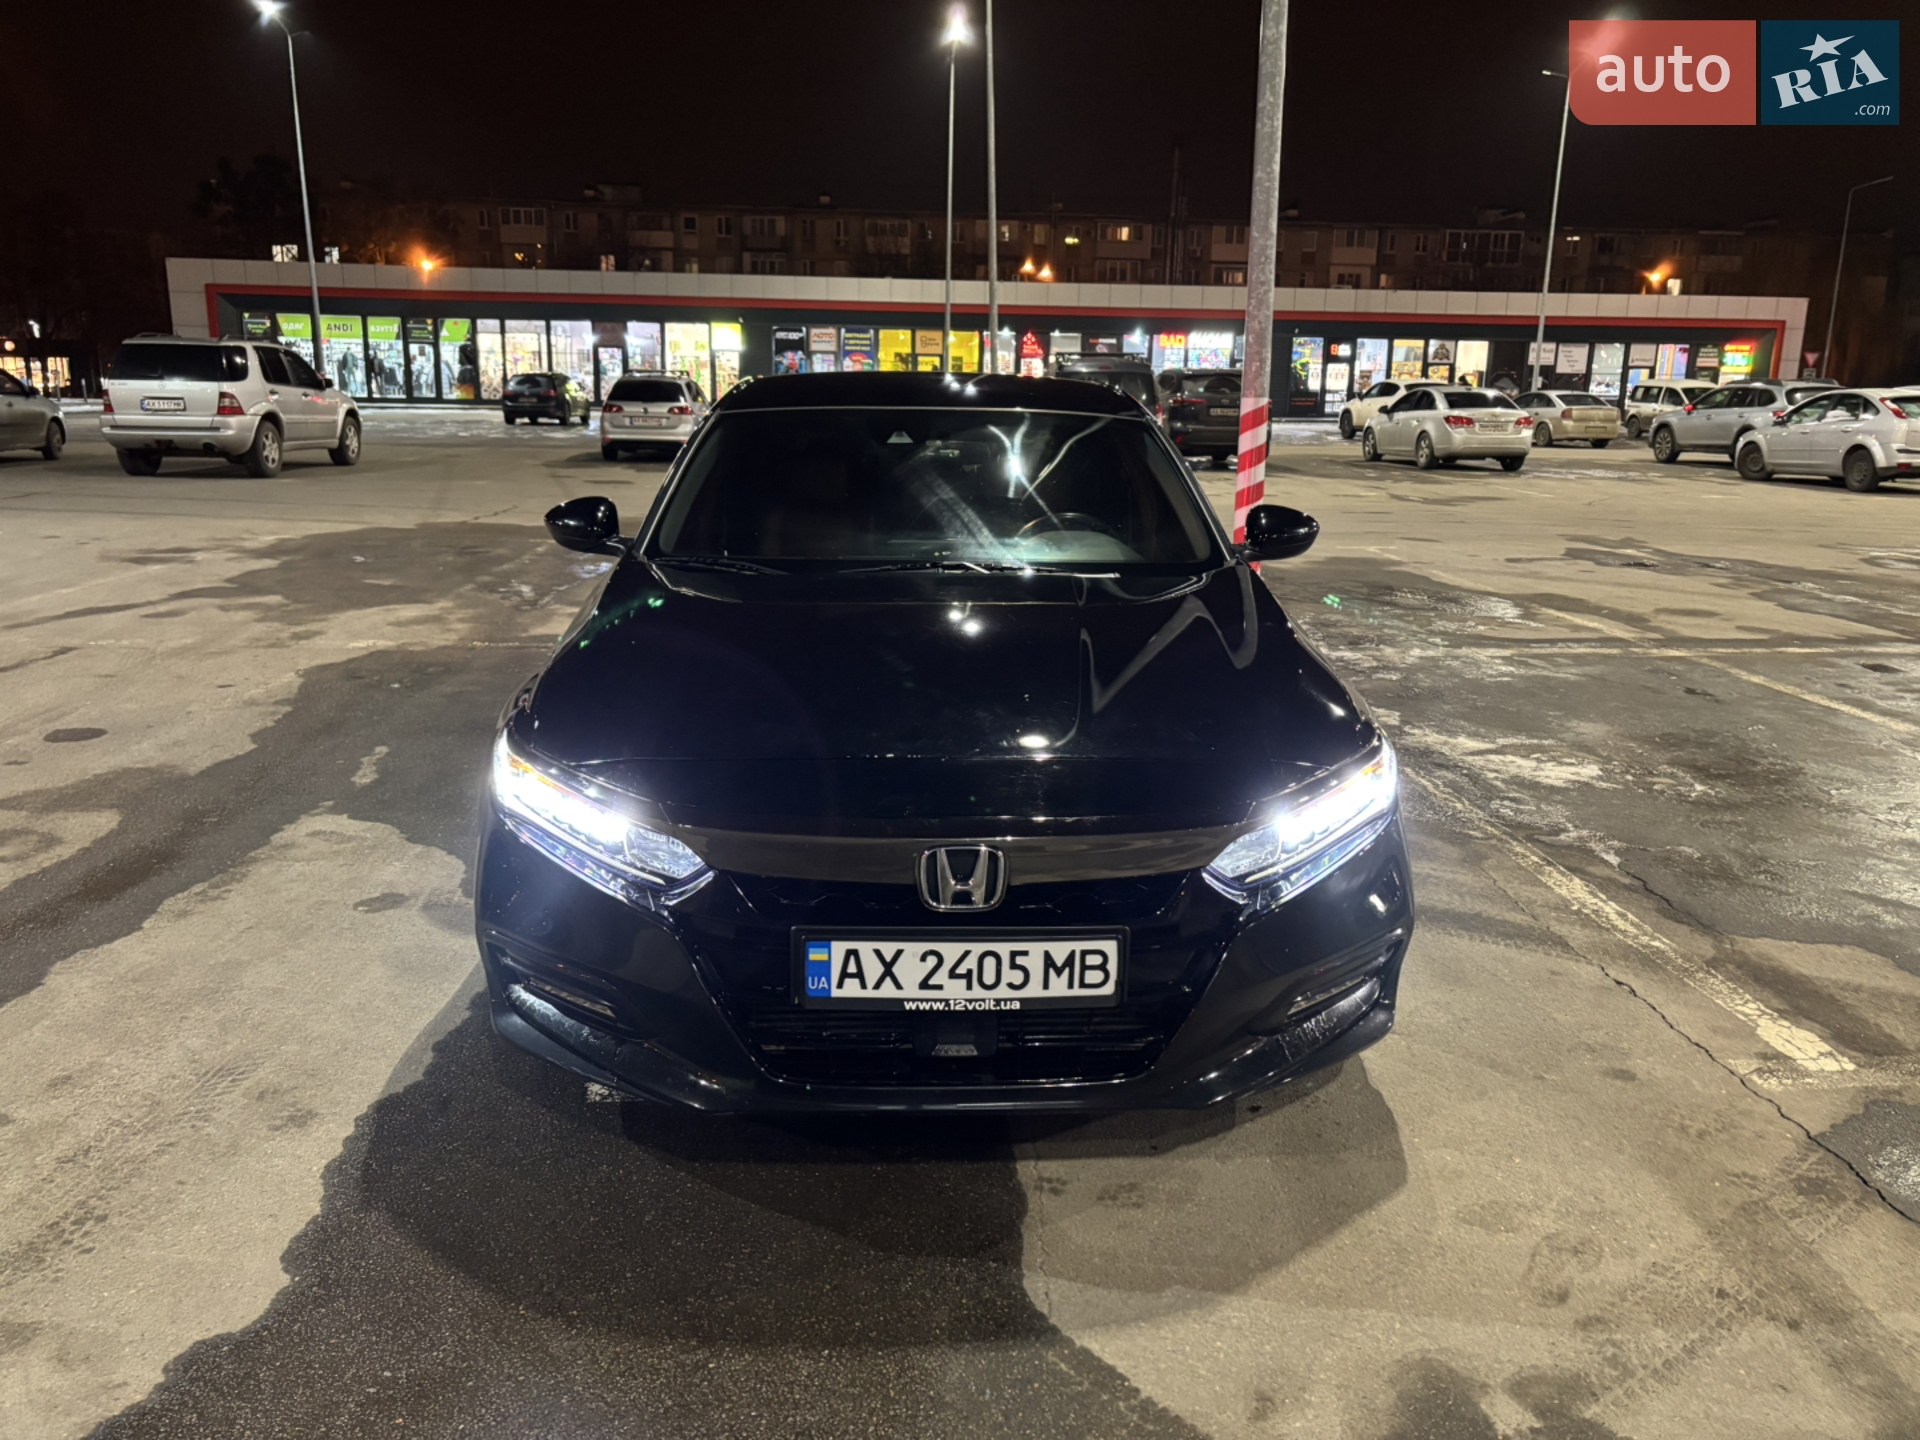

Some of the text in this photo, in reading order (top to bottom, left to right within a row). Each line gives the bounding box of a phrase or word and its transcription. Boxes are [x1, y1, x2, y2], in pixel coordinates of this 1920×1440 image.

[326, 323, 353, 332] ANDI
[836, 948, 1111, 991] AX 2405 MB
[808, 976, 829, 990] UA
[904, 999, 1021, 1011] www.12volt.ua
